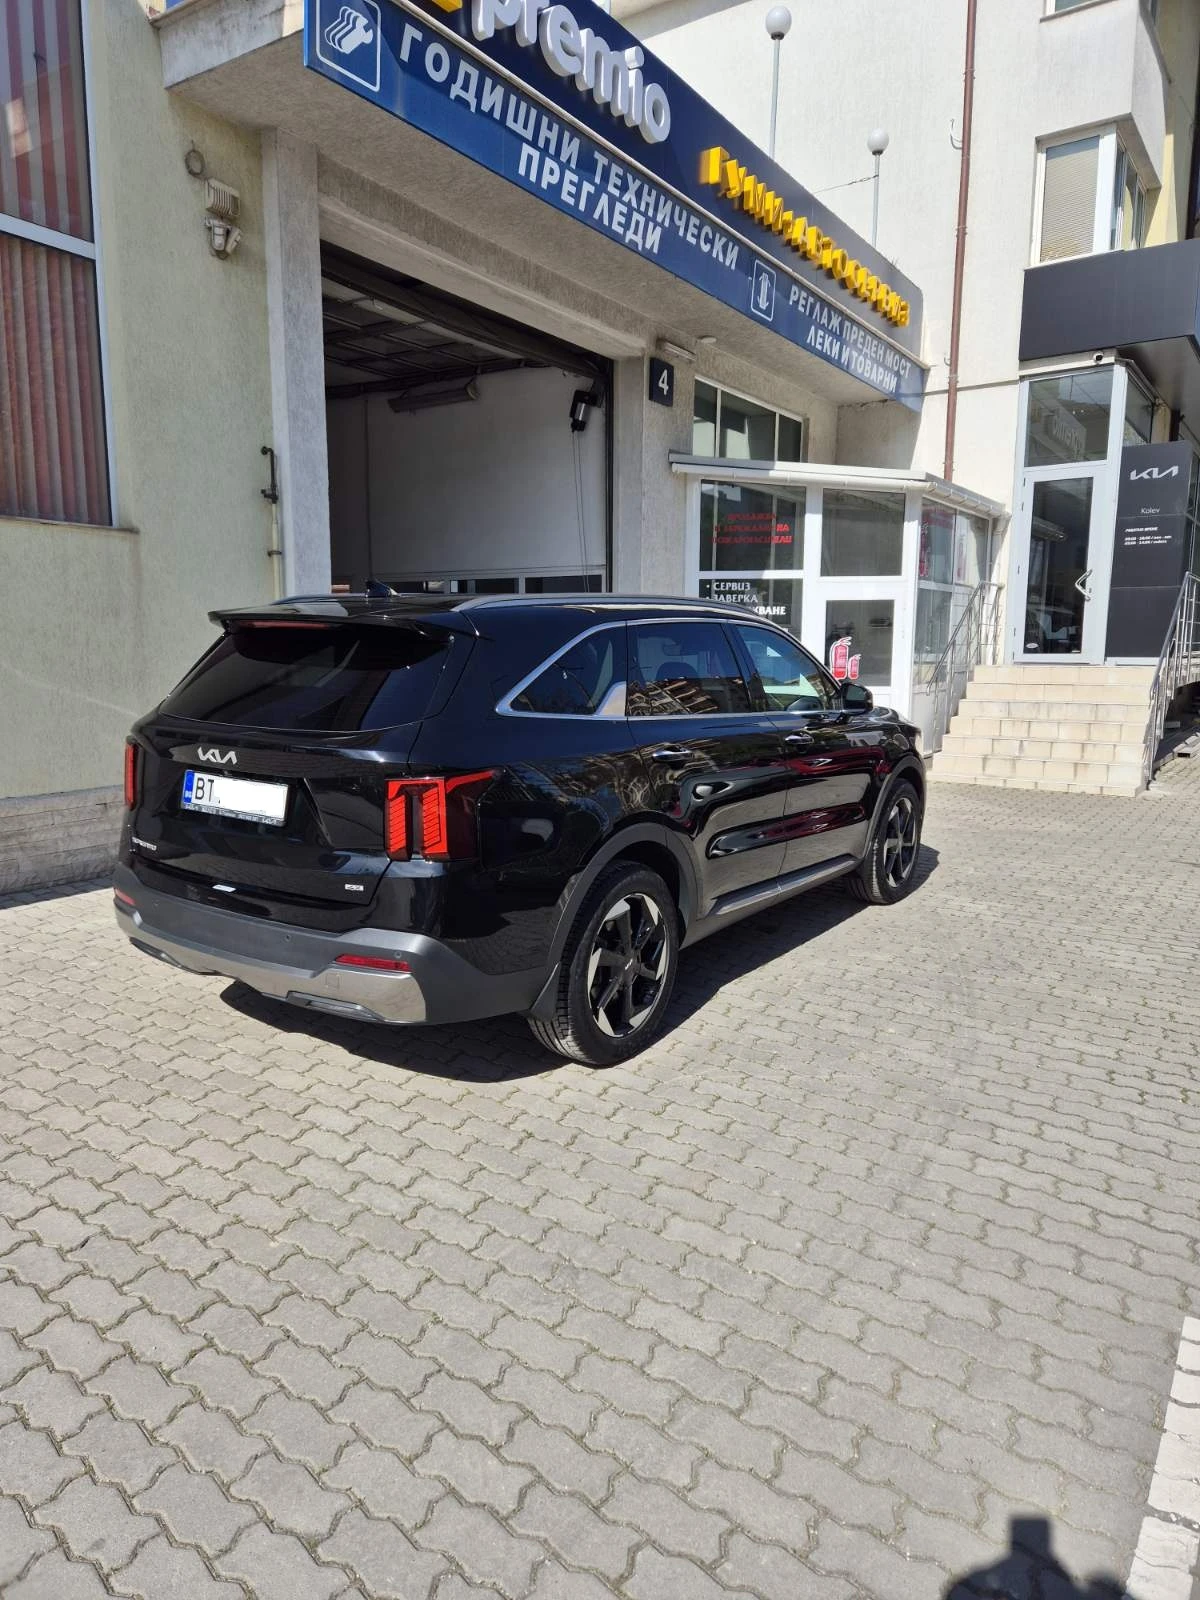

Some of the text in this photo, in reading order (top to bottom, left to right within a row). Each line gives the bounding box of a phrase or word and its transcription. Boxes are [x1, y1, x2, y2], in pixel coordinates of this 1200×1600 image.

[400, 23, 740, 271] ГОДИШНИ ТЕХНИЧЕСКИ
[518, 142, 662, 255] ПРЕГЛЕДИ
[789, 284, 912, 379] РЕГЛАЖ ПРЕДЕН МОСТ
[806, 325, 898, 393] ЛЕКИ И ТОВАРНИ
[658, 369, 669, 395] 4
[1130, 465, 1179, 481] KIA
[197, 746, 238, 765] KIA
